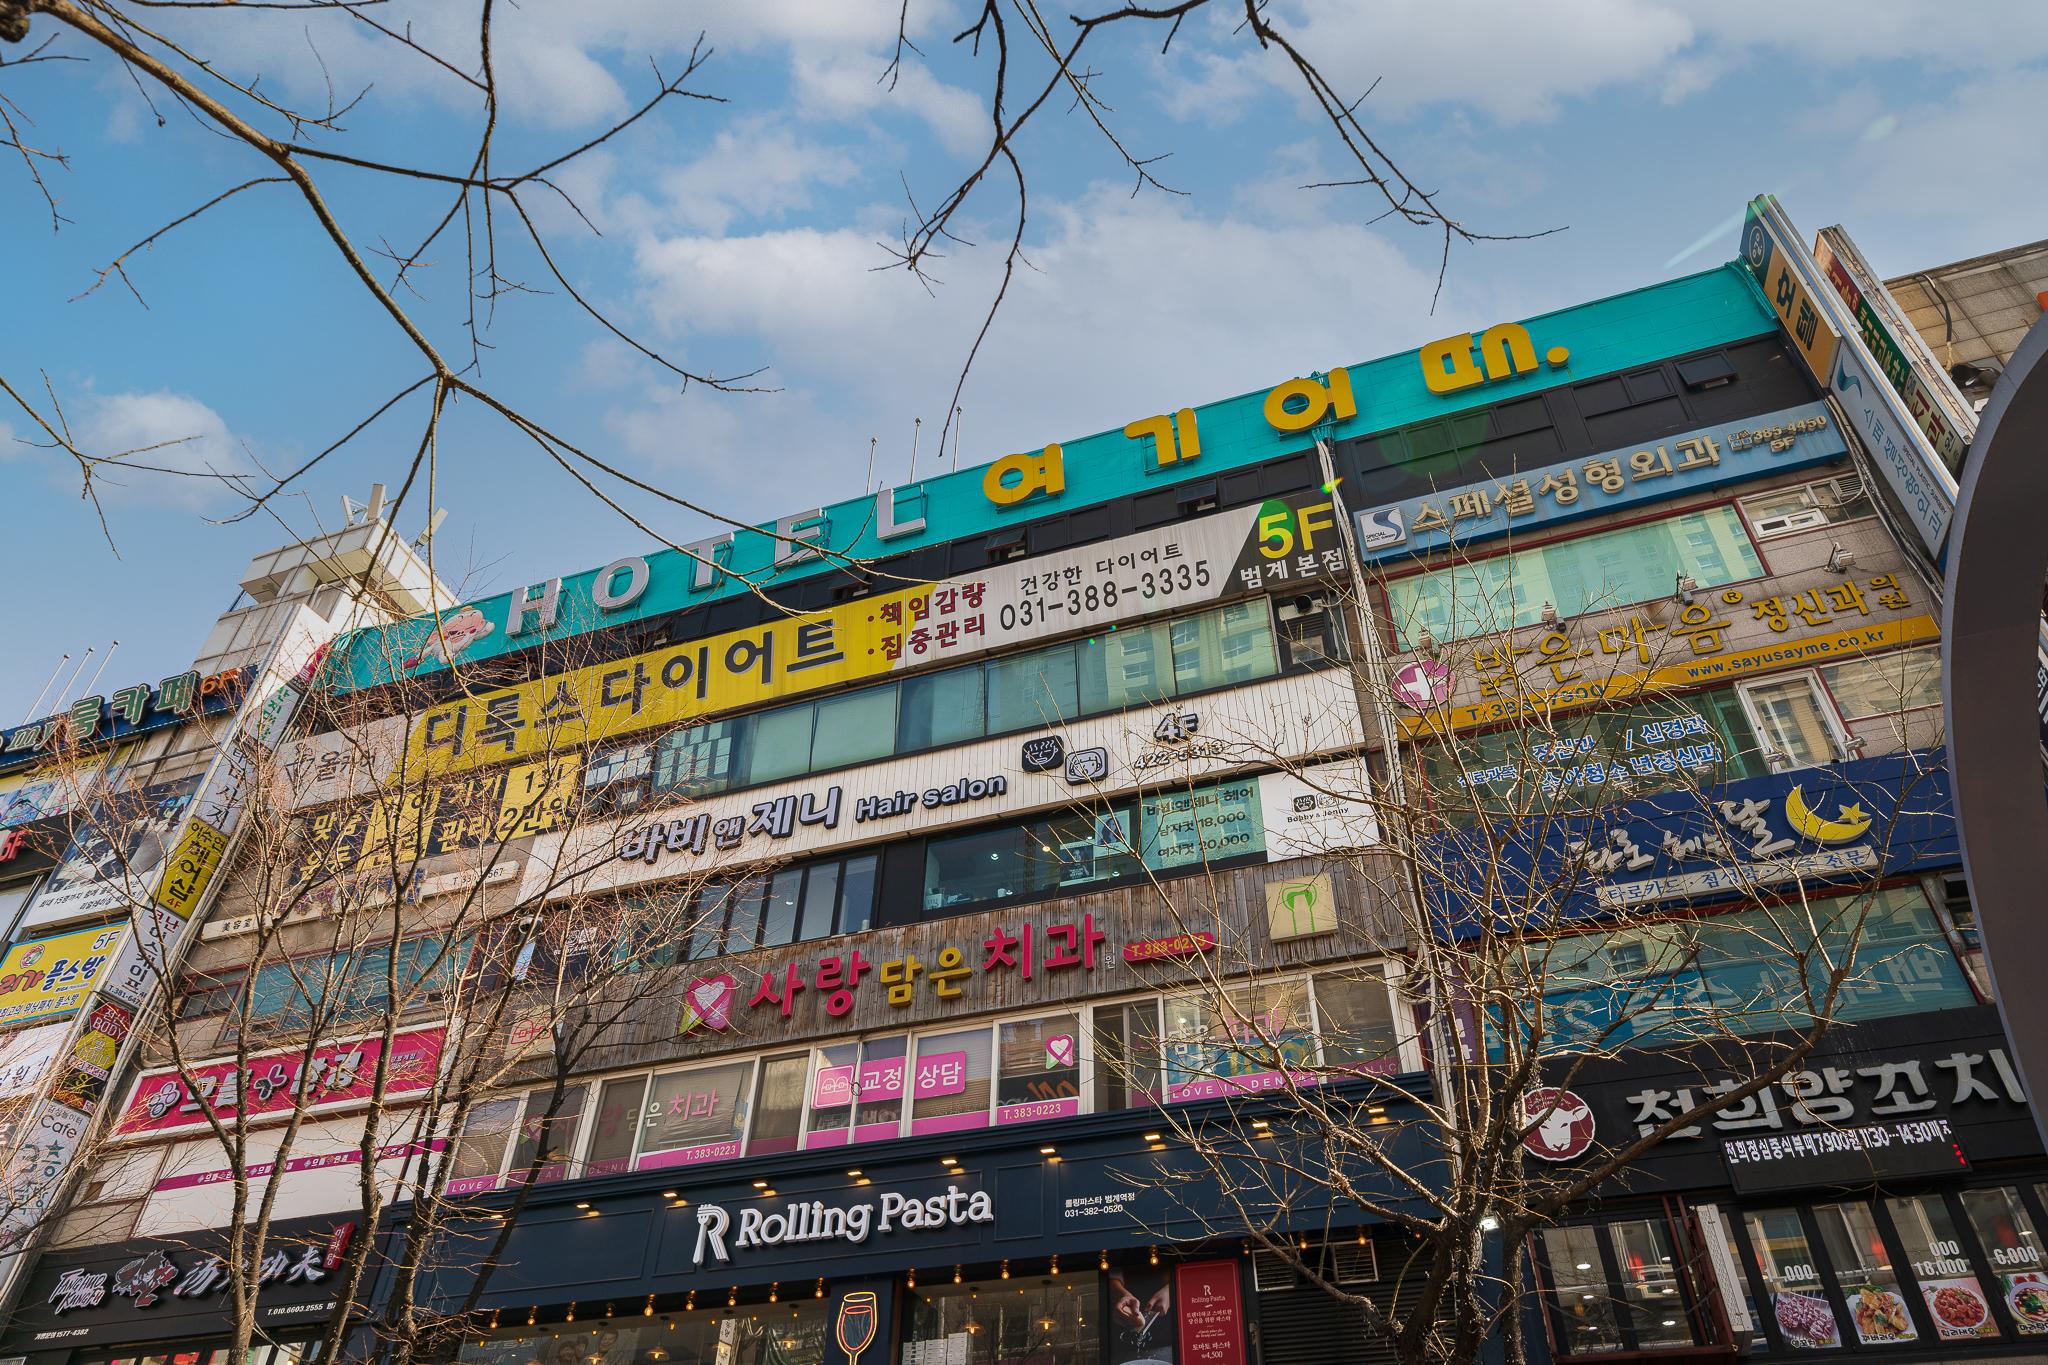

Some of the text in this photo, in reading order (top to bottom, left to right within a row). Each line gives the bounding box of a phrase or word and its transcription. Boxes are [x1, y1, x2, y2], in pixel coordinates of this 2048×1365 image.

[1753, 415, 1827, 444] 385-4450
[1412, 435, 1721, 533] 스페셜성형외과
[1864, 407, 1943, 541] 스페셜성형외과
[1258, 502, 1334, 559] 5F
[505, 485, 926, 637] HOTEL
[1020, 542, 1184, 596] 건강한 다이어트
[1240, 547, 1346, 590] 범계본점
[880, 582, 987, 626] 책임감량
[1000, 560, 1211, 631] 031-388-3335
[1752, 581, 1870, 632] 정신과
[1870, 573, 1912, 610] 의원
[881, 614, 987, 661] 집중관리
[1687, 630, 1886, 679] www.sayusayme.co.kr
[426, 617, 845, 757] 디톡스다이어트
[1153, 713, 1198, 744] 4F
[1640, 714, 1709, 745] 신경과
[1222, 785, 1255, 804] 헤어
[619, 772, 1006, 864] 바비앤제니 Hair salon
[1158, 811, 1247, 837] 남자컷 18,000
[1718, 798, 1797, 861] 달
[1157, 841, 1195, 858] 여자컷
[169, 839, 211, 903] 헤어샵
[1608, 875, 1685, 900] 타로카드
[166, 896, 182, 909] 4F
[92, 930, 121, 952] 5F
[1131, 934, 1206, 957] T.383-023
[42, 955, 106, 991] 플스방
[93, 1017, 126, 1042] BODY
[863, 1062, 962, 1091] 교정 상담
[1172, 1085, 1214, 1099] LOVE
[1626, 1048, 2028, 1139] 천희양꼬치
[1004, 1103, 1061, 1120] T.383-0223
[41, 1116, 77, 1139] Cafe
[686, 1145, 736, 1161] T.383-0223
[452, 1182, 483, 1193] LOVE
[1104, 1192, 1136, 1204] 범계역점
[736, 1201, 874, 1248] Rolling
[878, 1185, 994, 1234] Pasta
[1065, 1204, 1124, 1218] 031-382-0520
[1915, 1259, 1968, 1276] 18,000
[1993, 1247, 2040, 1265] 6,000
[267, 1303, 324, 1315] T.010.6603.2555
[1192, 1340, 1231, 1351] 토마토 파스타
